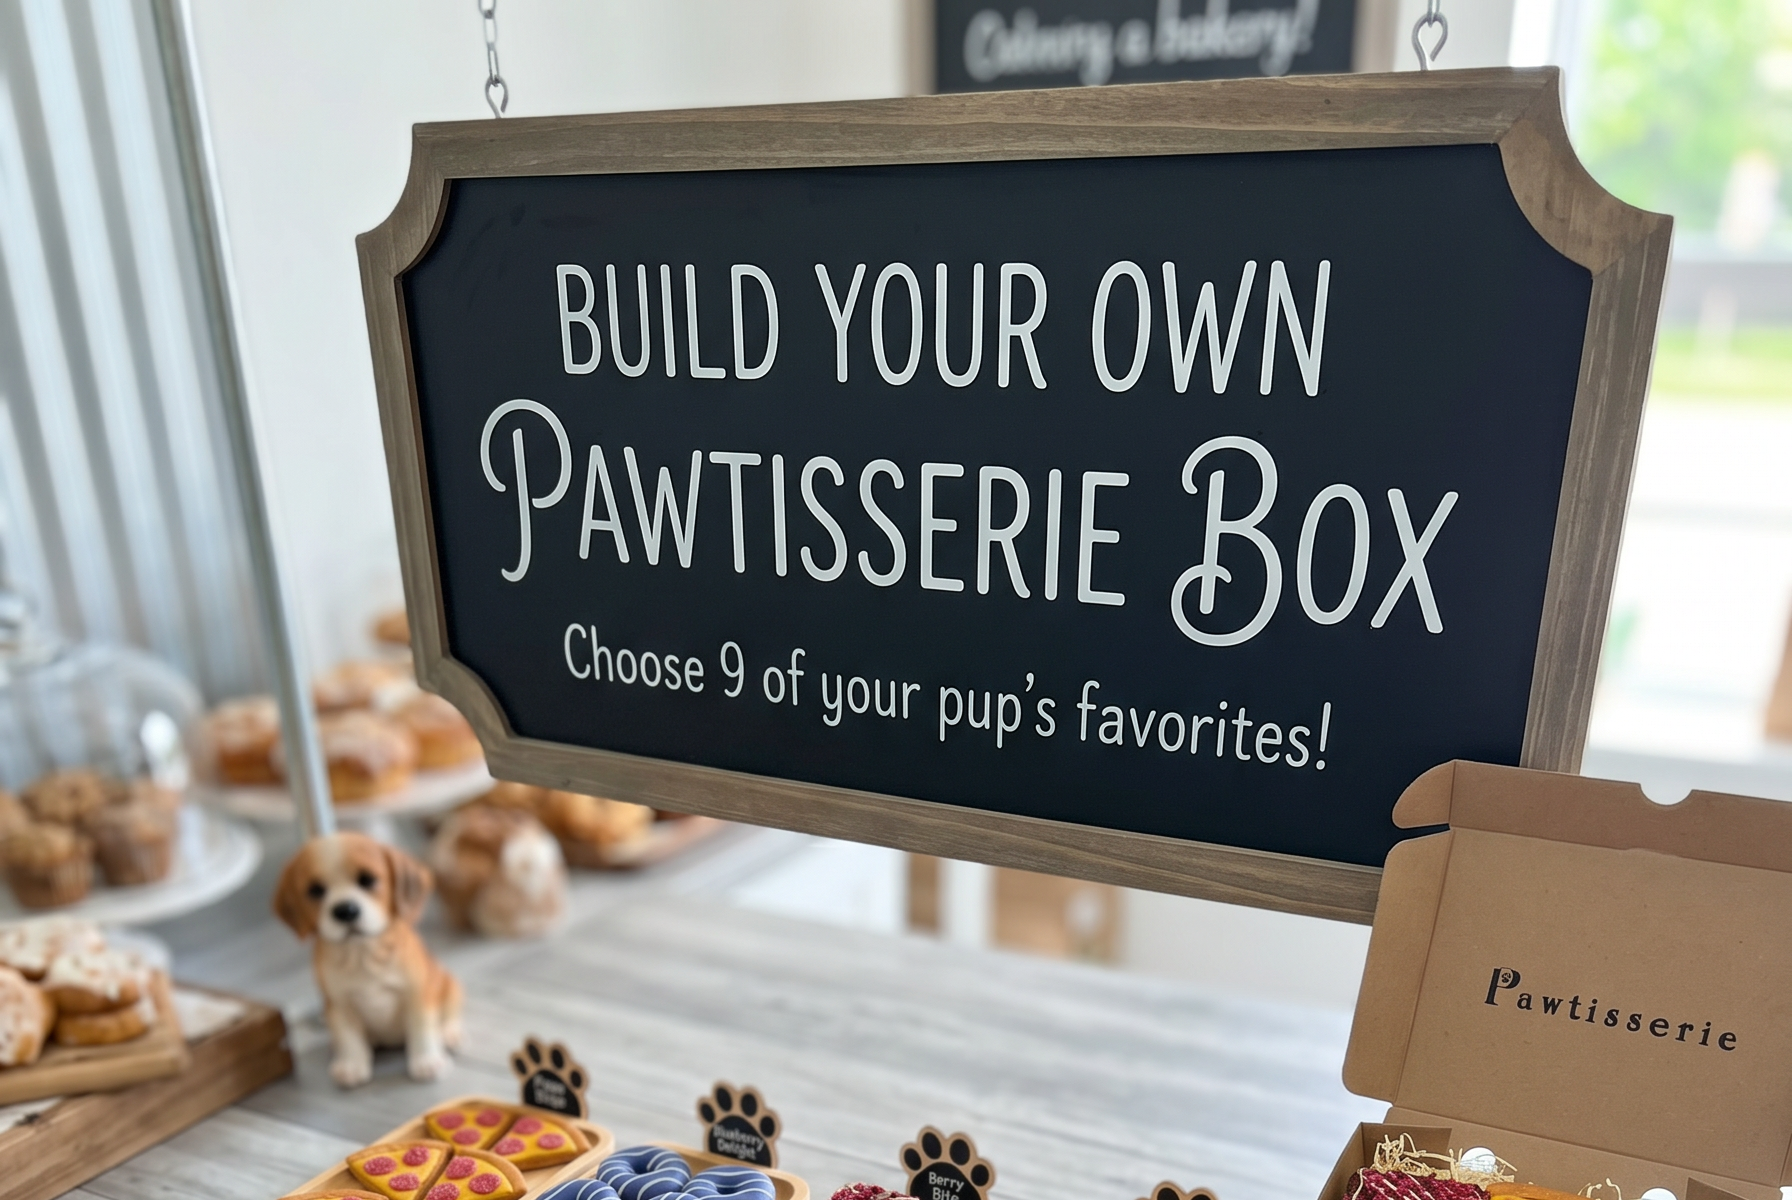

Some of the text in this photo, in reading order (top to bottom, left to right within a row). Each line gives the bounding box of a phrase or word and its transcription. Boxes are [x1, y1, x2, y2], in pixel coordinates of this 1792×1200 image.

[556, 259, 1331, 397] BUILD YOUR OWN
[480, 398, 1459, 647] PAWTISSERIE BOX
[564, 623, 704, 693] Choose
[720, 641, 745, 698] 9
[763, 648, 806, 706] of
[821, 672, 921, 727] your
[1076, 680, 1332, 770] favorites!
[1484, 966, 1738, 1052] Pawtisserie
[928, 1171, 964, 1193] Berry
